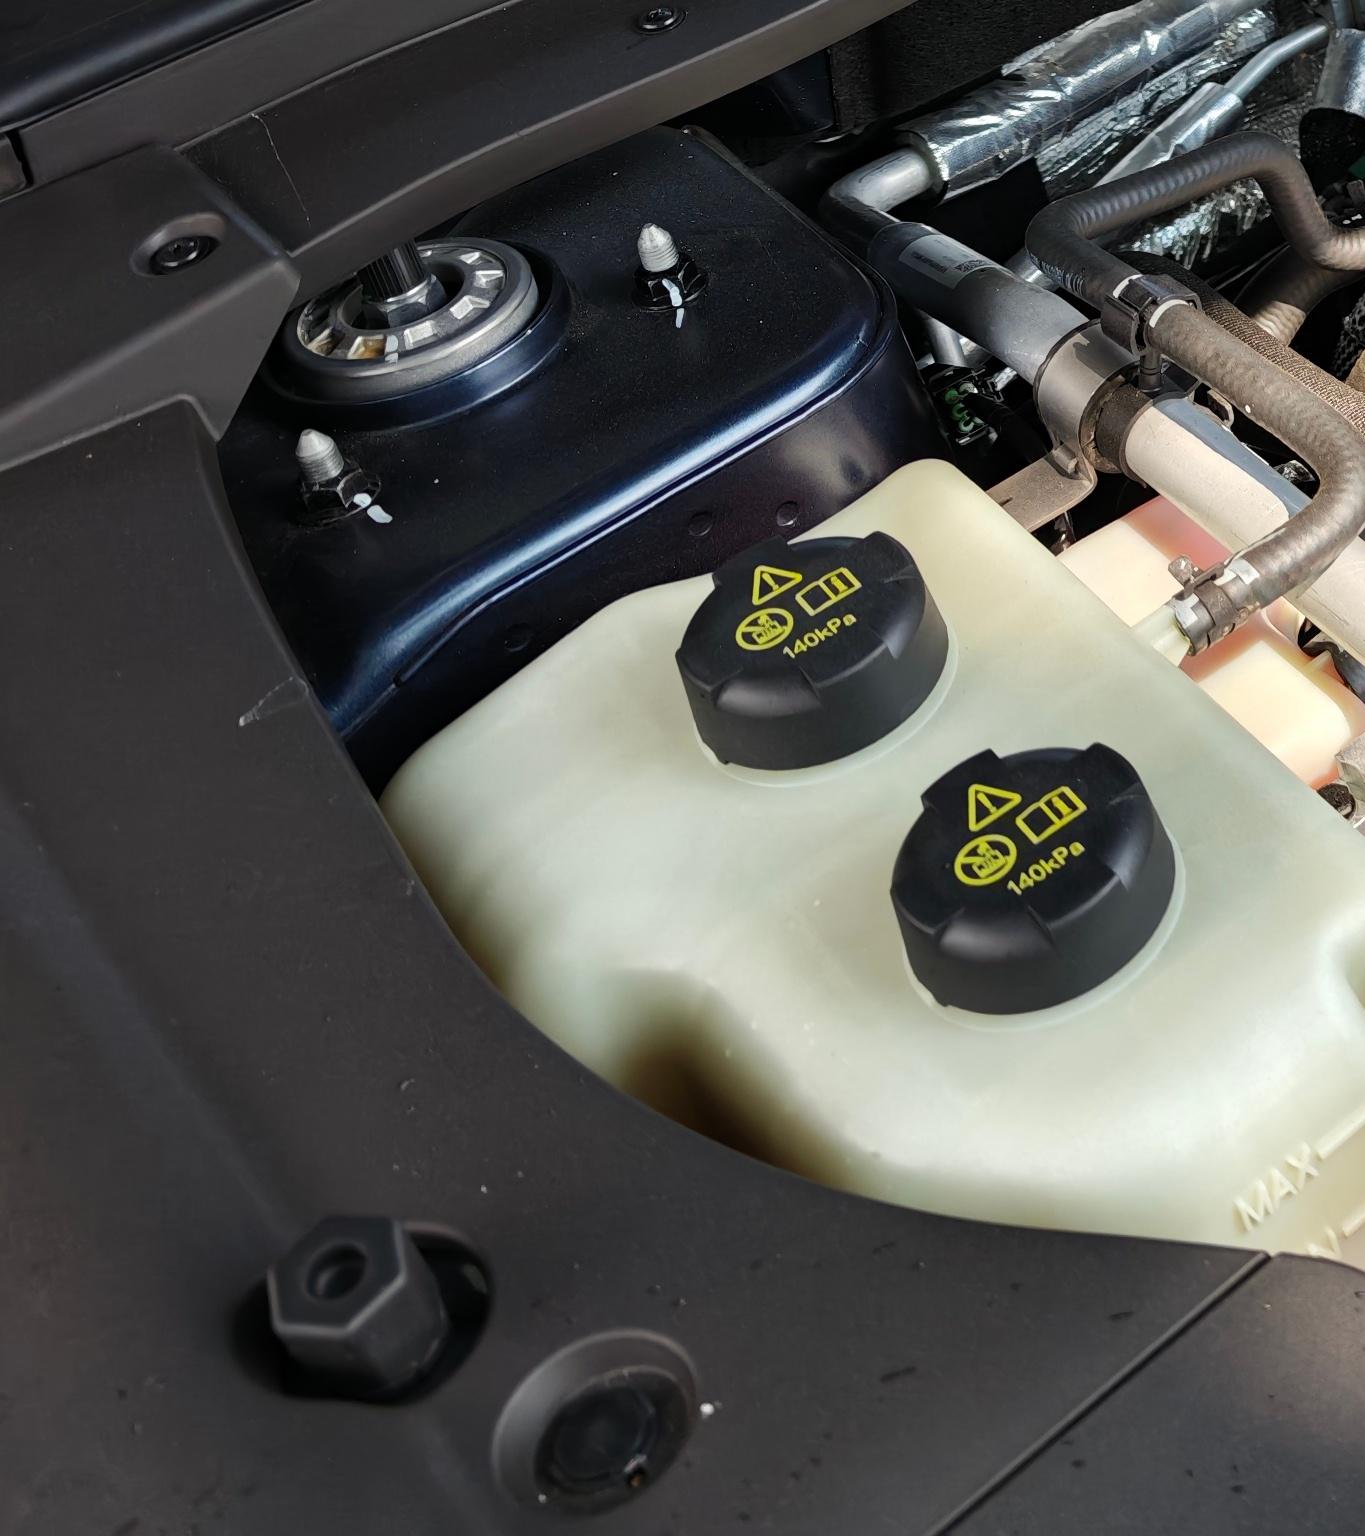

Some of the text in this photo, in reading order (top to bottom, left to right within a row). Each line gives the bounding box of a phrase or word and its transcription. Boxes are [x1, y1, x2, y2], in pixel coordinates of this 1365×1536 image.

[783, 614, 857, 659] 140kPa
[1008, 842, 1085, 896] 140kPa
[1233, 1141, 1319, 1233] MAX
